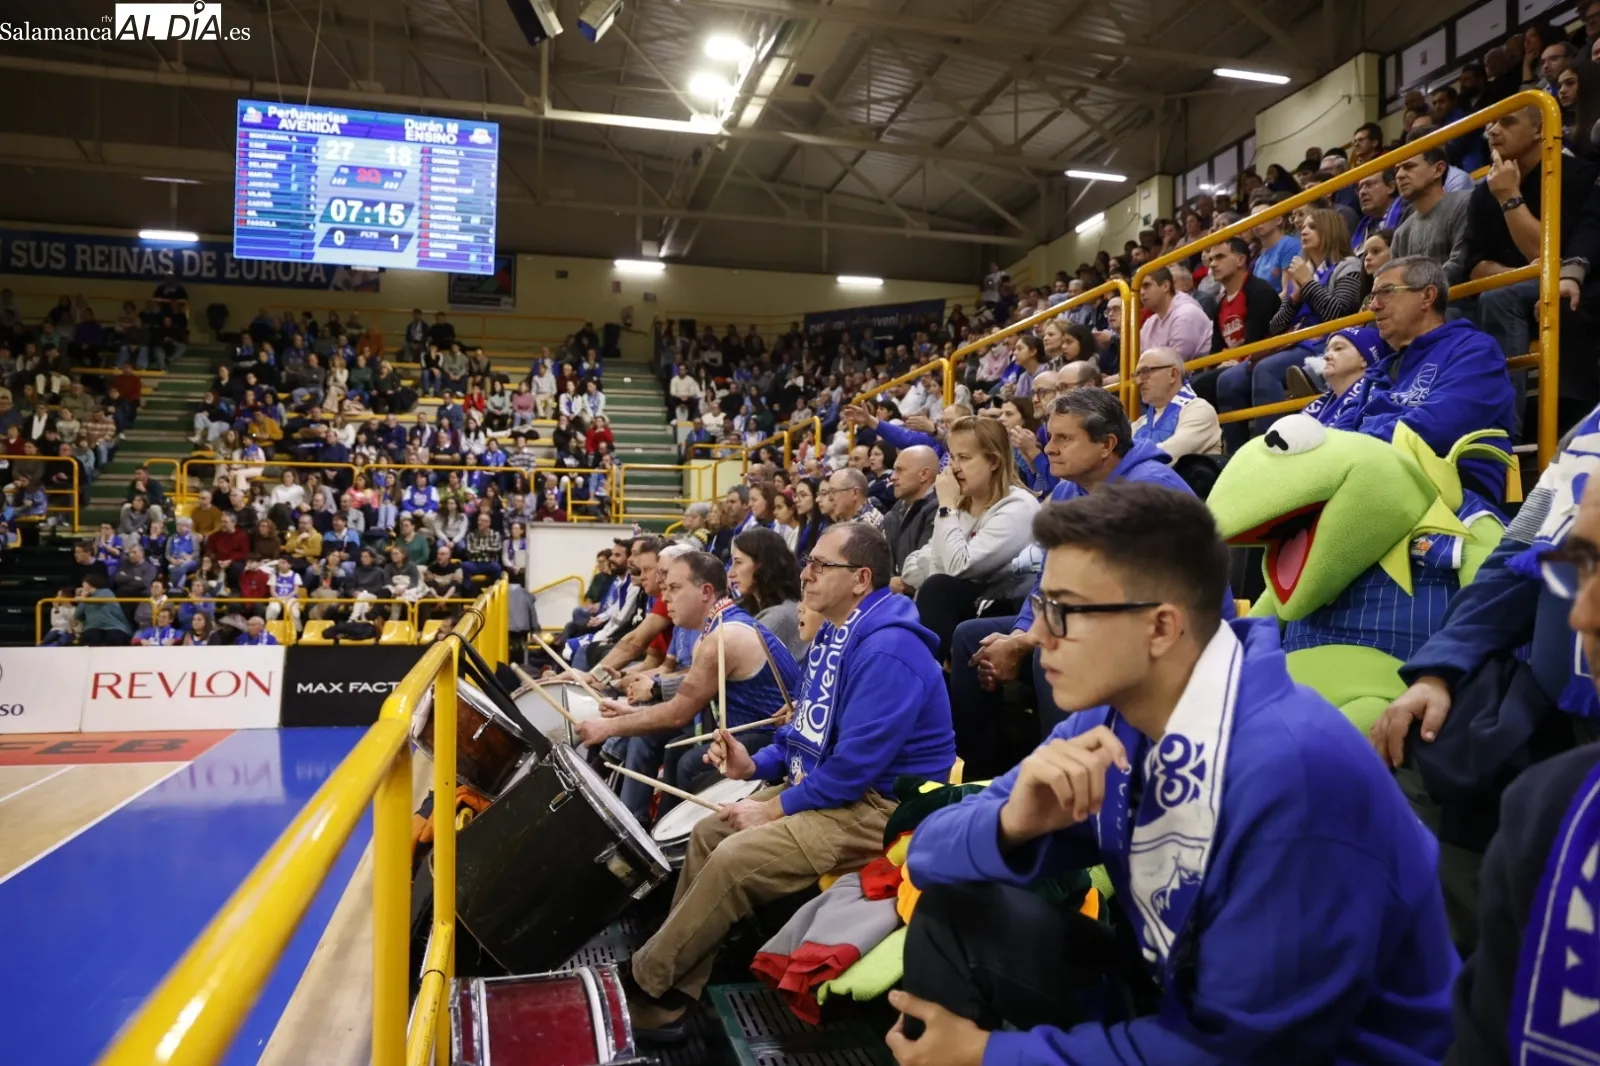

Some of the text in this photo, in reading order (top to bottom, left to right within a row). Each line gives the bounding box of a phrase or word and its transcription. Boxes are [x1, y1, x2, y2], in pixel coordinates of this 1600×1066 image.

[278, 119, 341, 134] AVENIDA
[405, 130, 457, 144] ENSINO
[324, 139, 355, 161] 27
[385, 144, 413, 166] 18
[330, 198, 405, 226] 07:15
[333, 230, 346, 246] 0
[390, 234, 399, 250] 1
[10, 239, 327, 282] SUS REINAS DE EUROPA
[91, 670, 275, 700] REVLON
[297, 682, 343, 693] MAX
